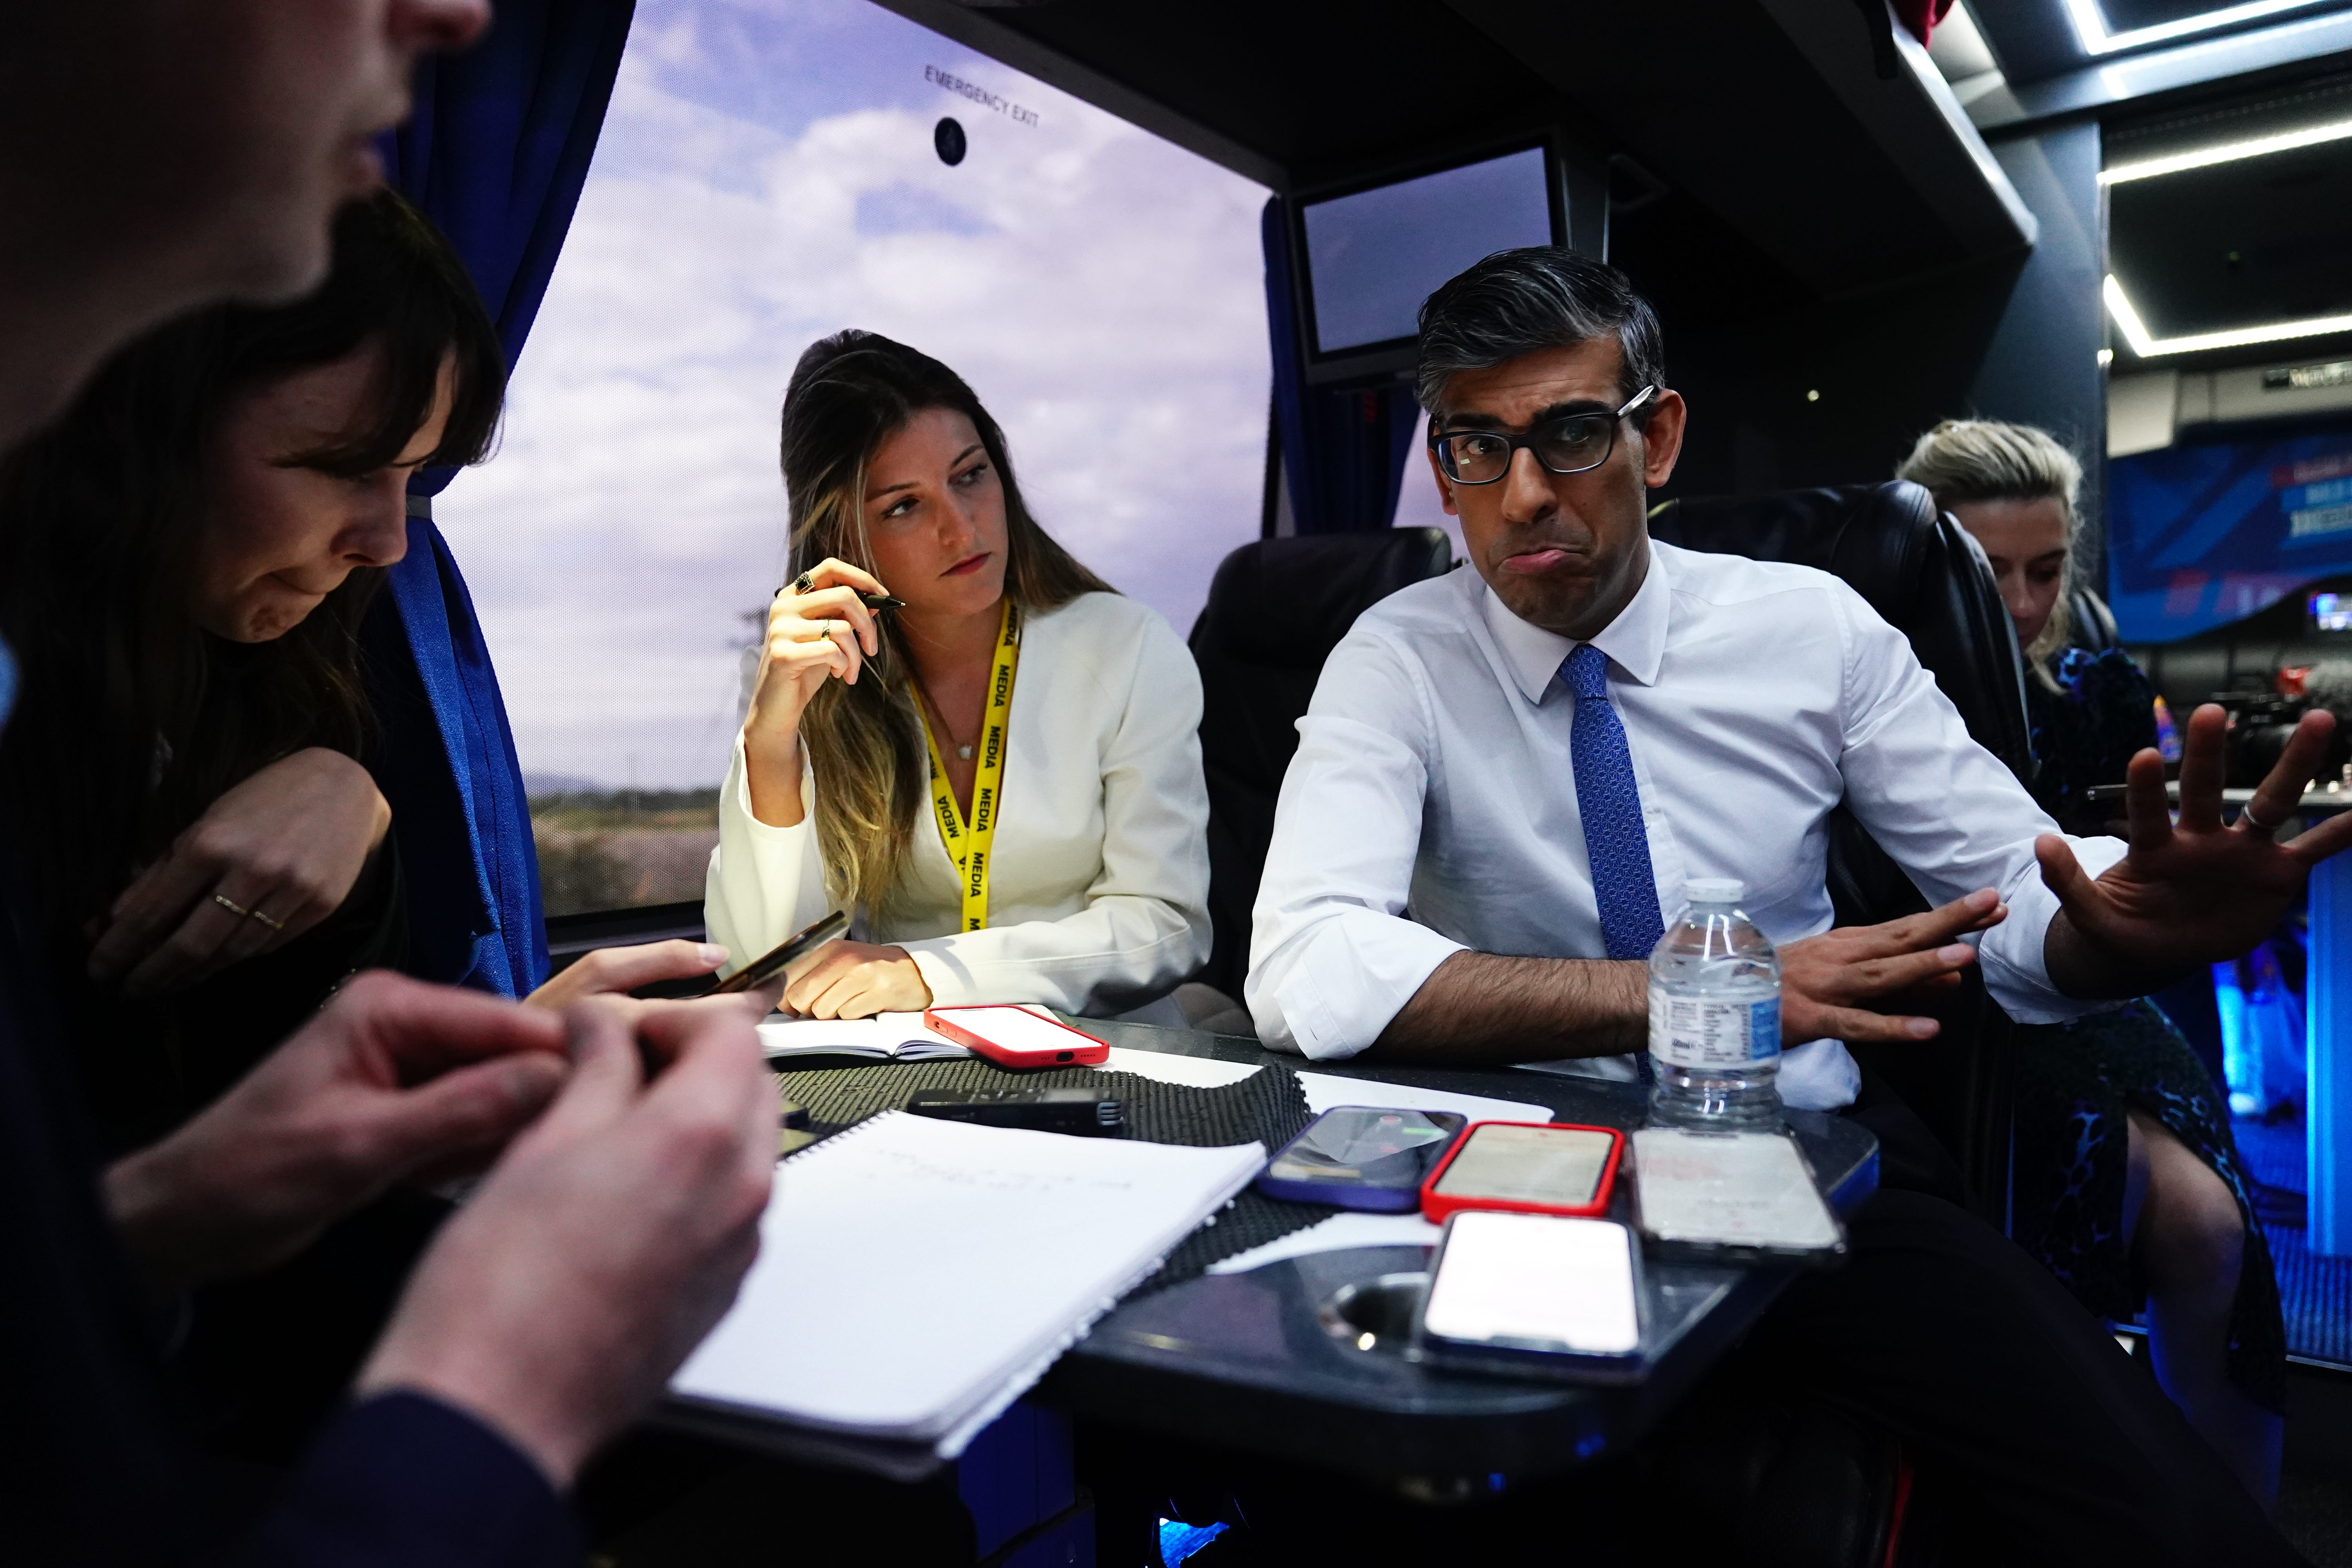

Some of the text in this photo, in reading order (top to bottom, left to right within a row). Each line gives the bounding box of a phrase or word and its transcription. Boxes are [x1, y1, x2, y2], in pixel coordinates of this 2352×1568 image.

[925, 64, 1039, 128] EMERGENCY EXIT
[994, 664, 1010, 708] MEDIA
[985, 726, 1001, 769] MEDIA
[938, 795, 960, 838] MEDIA
[976, 788, 992, 832] MEDIA
[970, 852, 984, 897] MEDIA
